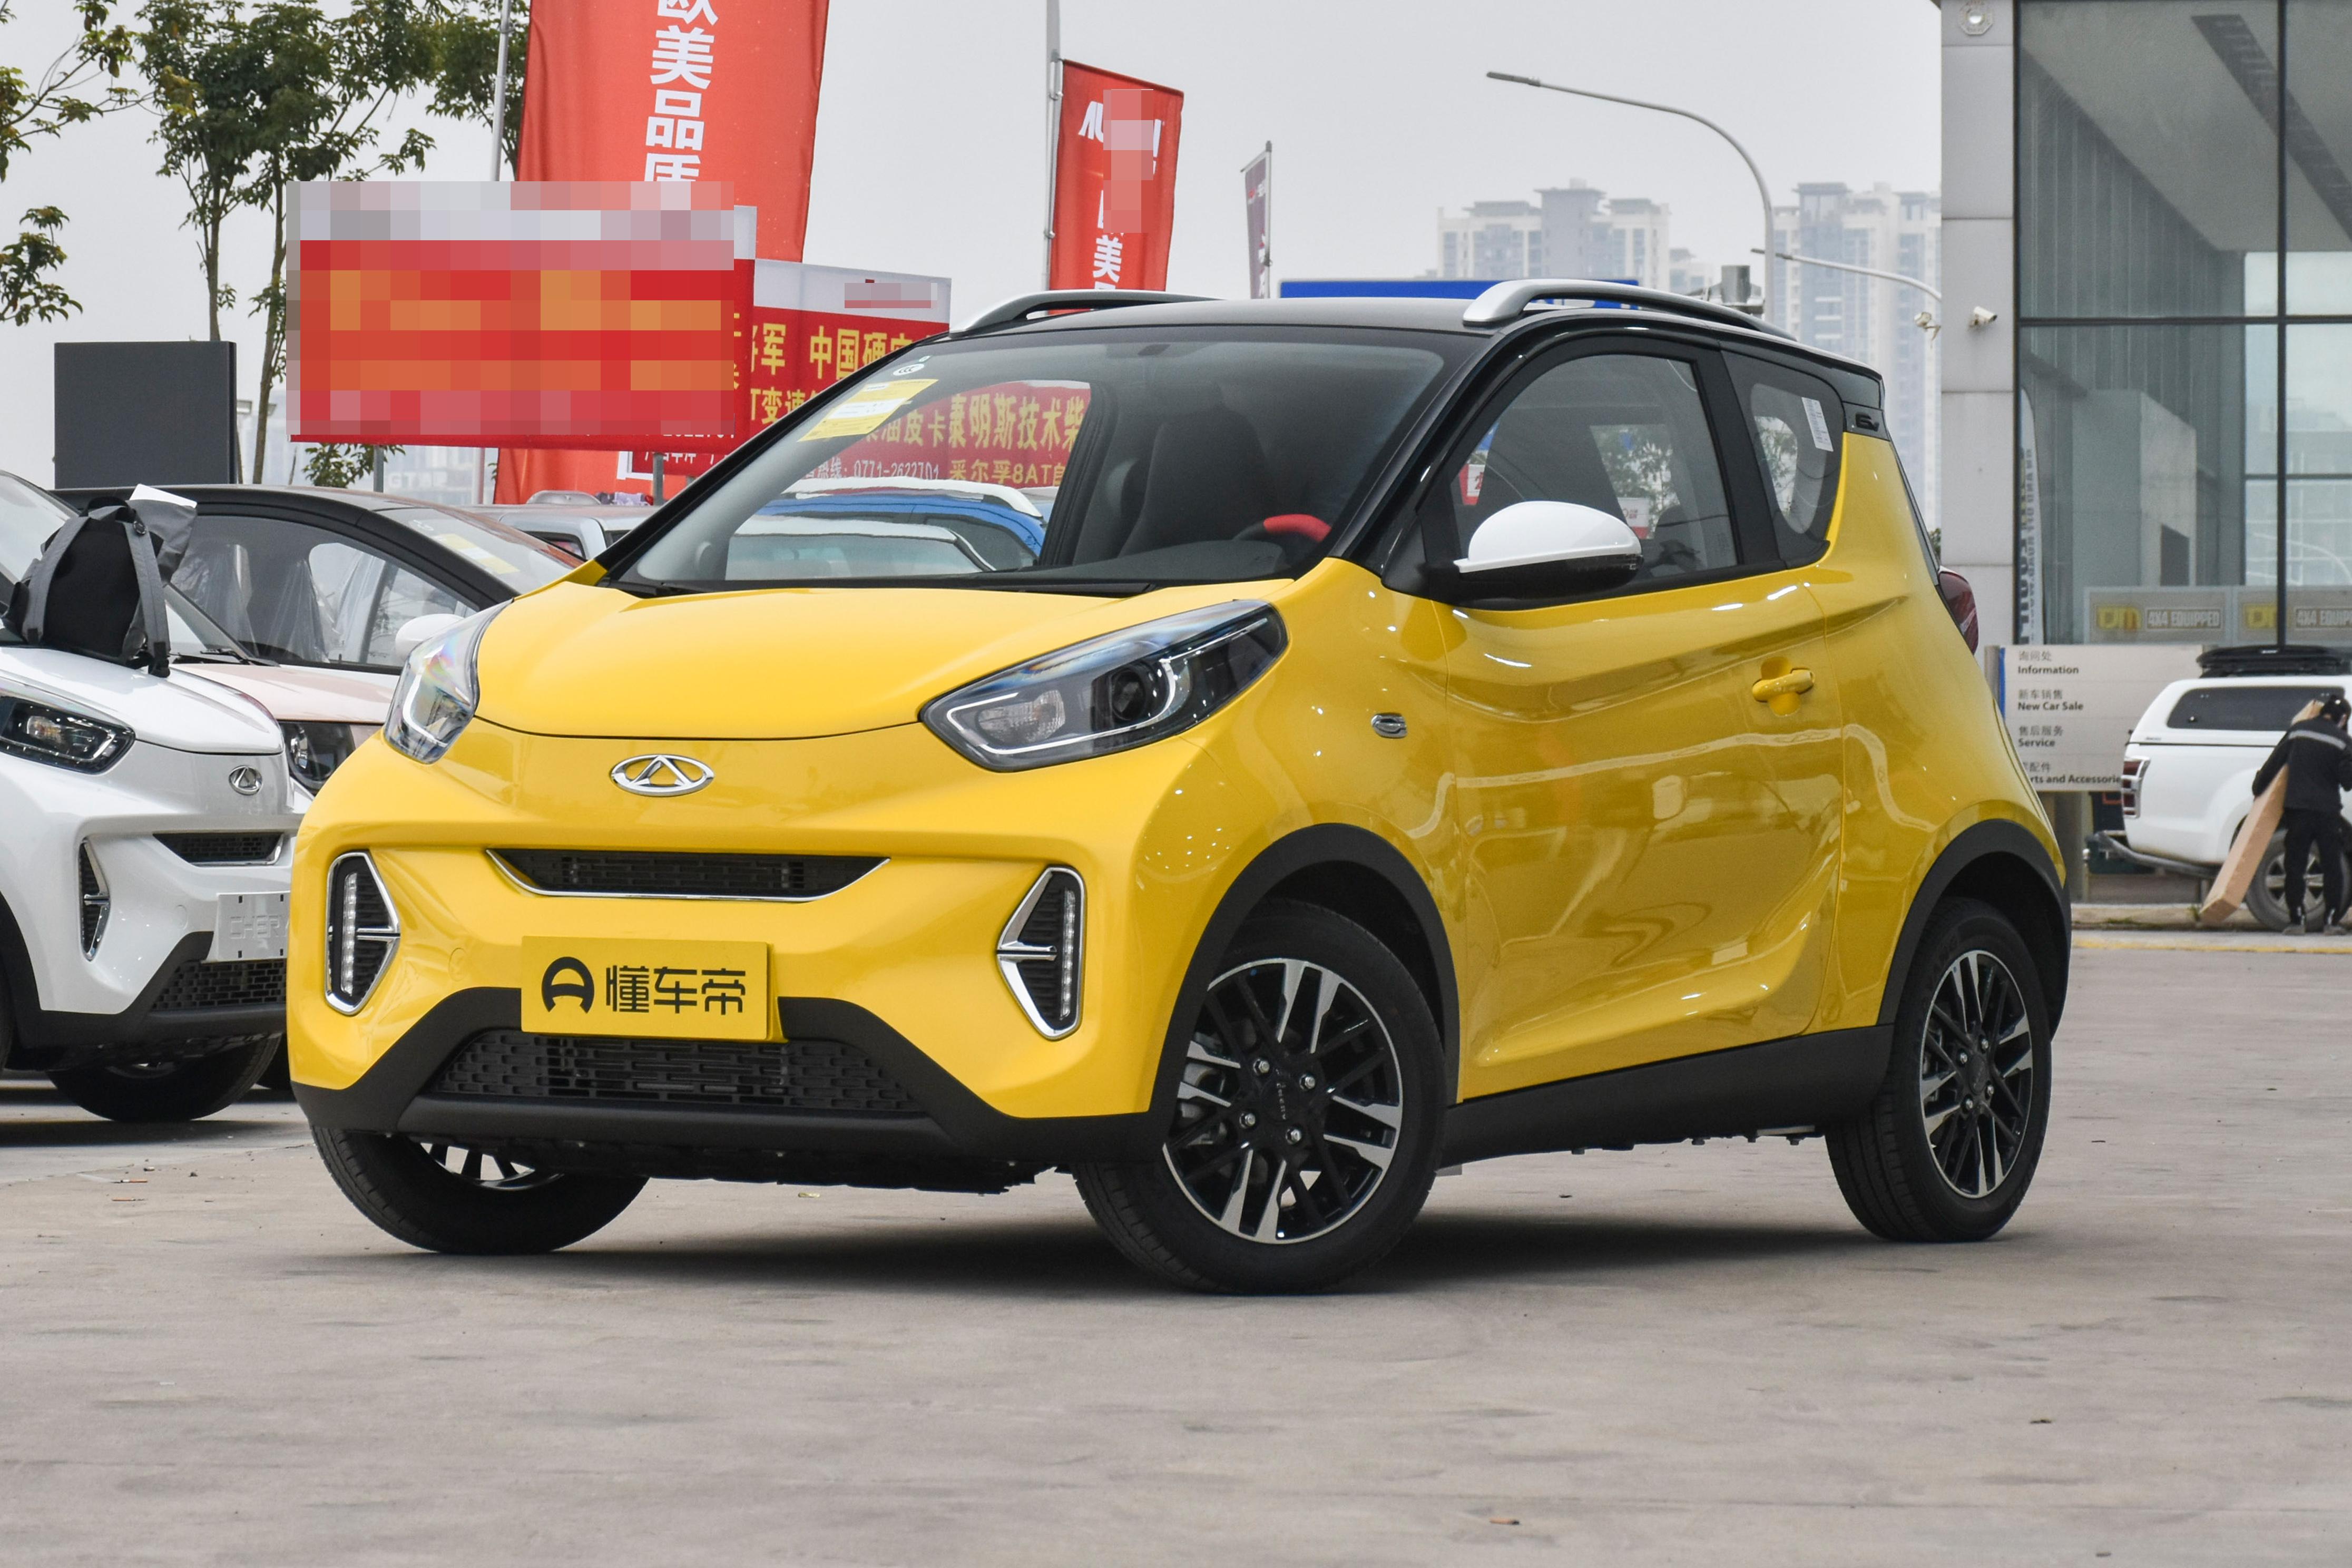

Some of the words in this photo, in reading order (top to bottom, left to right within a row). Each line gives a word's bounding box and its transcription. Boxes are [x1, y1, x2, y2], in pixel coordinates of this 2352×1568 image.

[751, 322, 786, 375] 军
[810, 325, 913, 380] 中国硬
[750, 386, 818, 425] T变速
[2018, 665, 2079, 674] Information
[2043, 702, 2059, 710] Car
[2062, 701, 2084, 710] Sale
[2046, 774, 2065, 783] and
[2068, 775, 2121, 783] Accessorie
[230, 915, 290, 939] CHER
[606, 965, 746, 1015] 懂车帝
